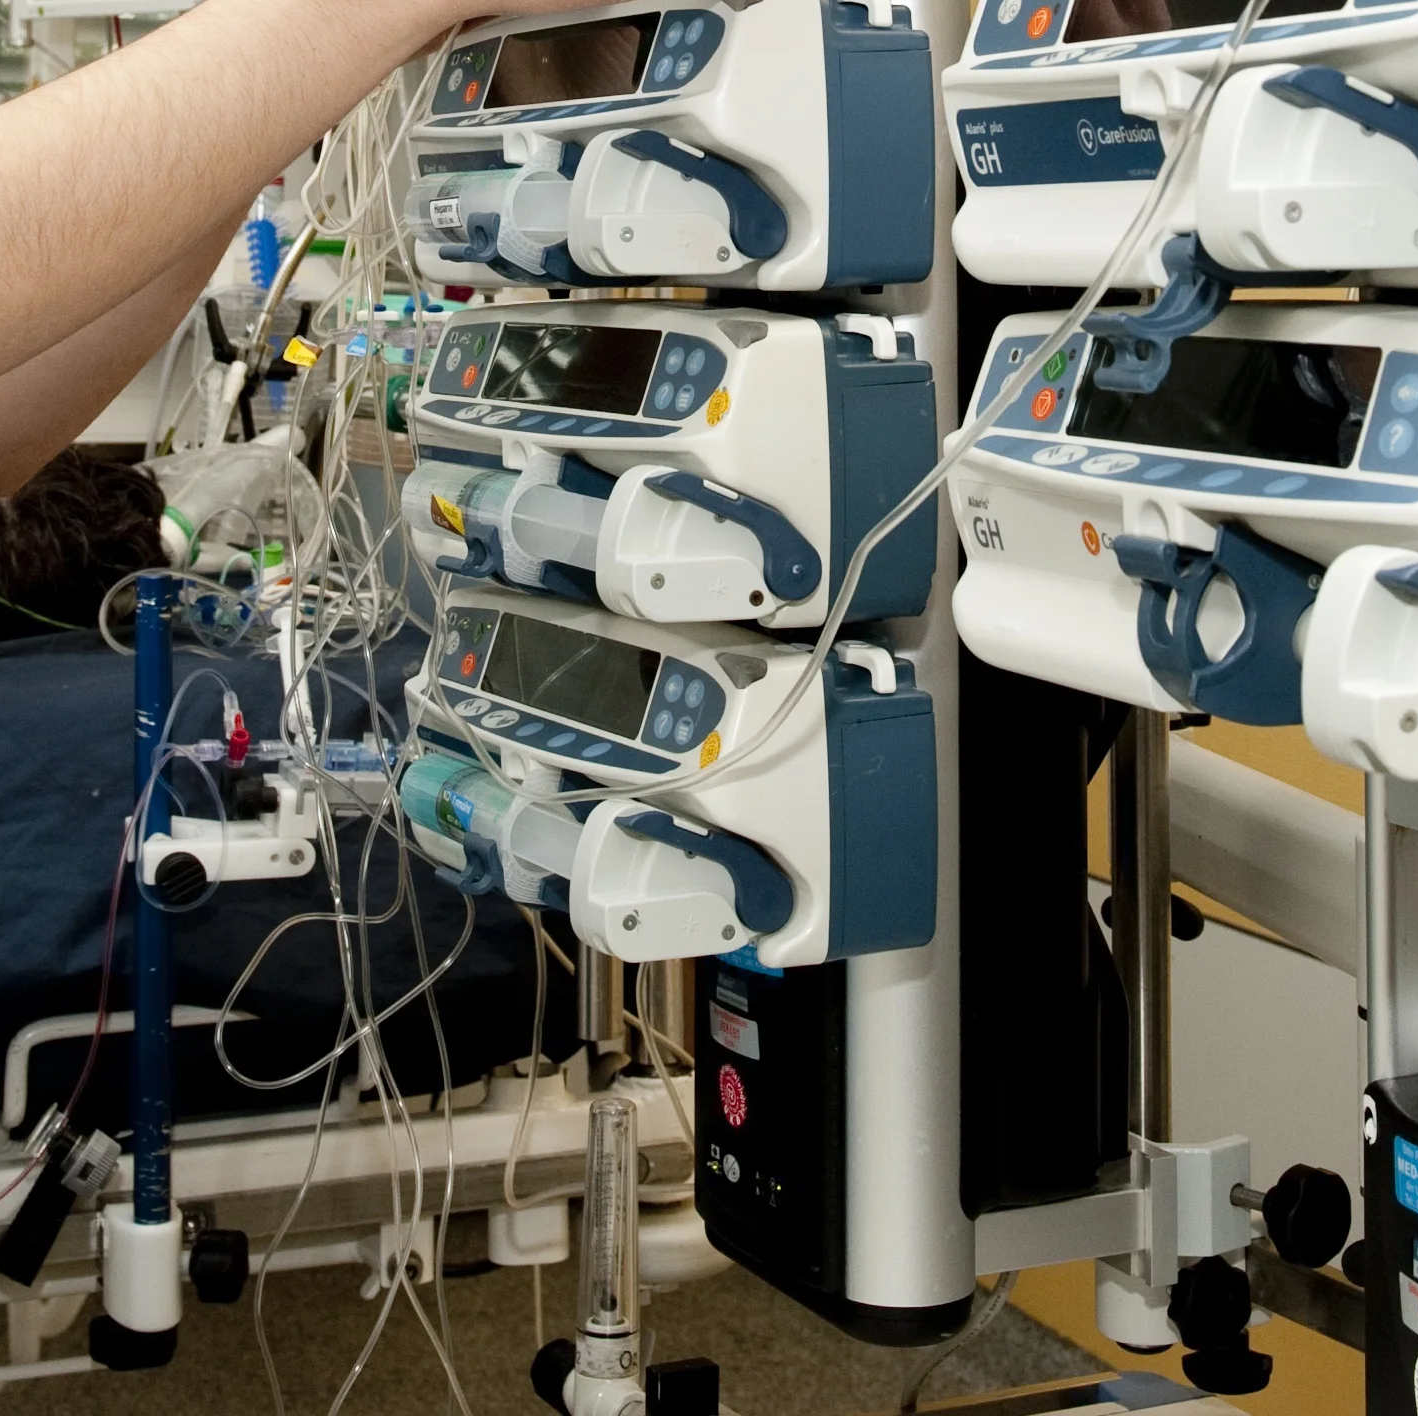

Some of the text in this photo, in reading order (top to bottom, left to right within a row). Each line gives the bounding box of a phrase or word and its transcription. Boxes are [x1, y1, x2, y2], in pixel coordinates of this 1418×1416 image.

[1097, 125, 1156, 146] CareFusion
[970, 141, 1003, 175] GH
[973, 516, 1005, 551] GH
